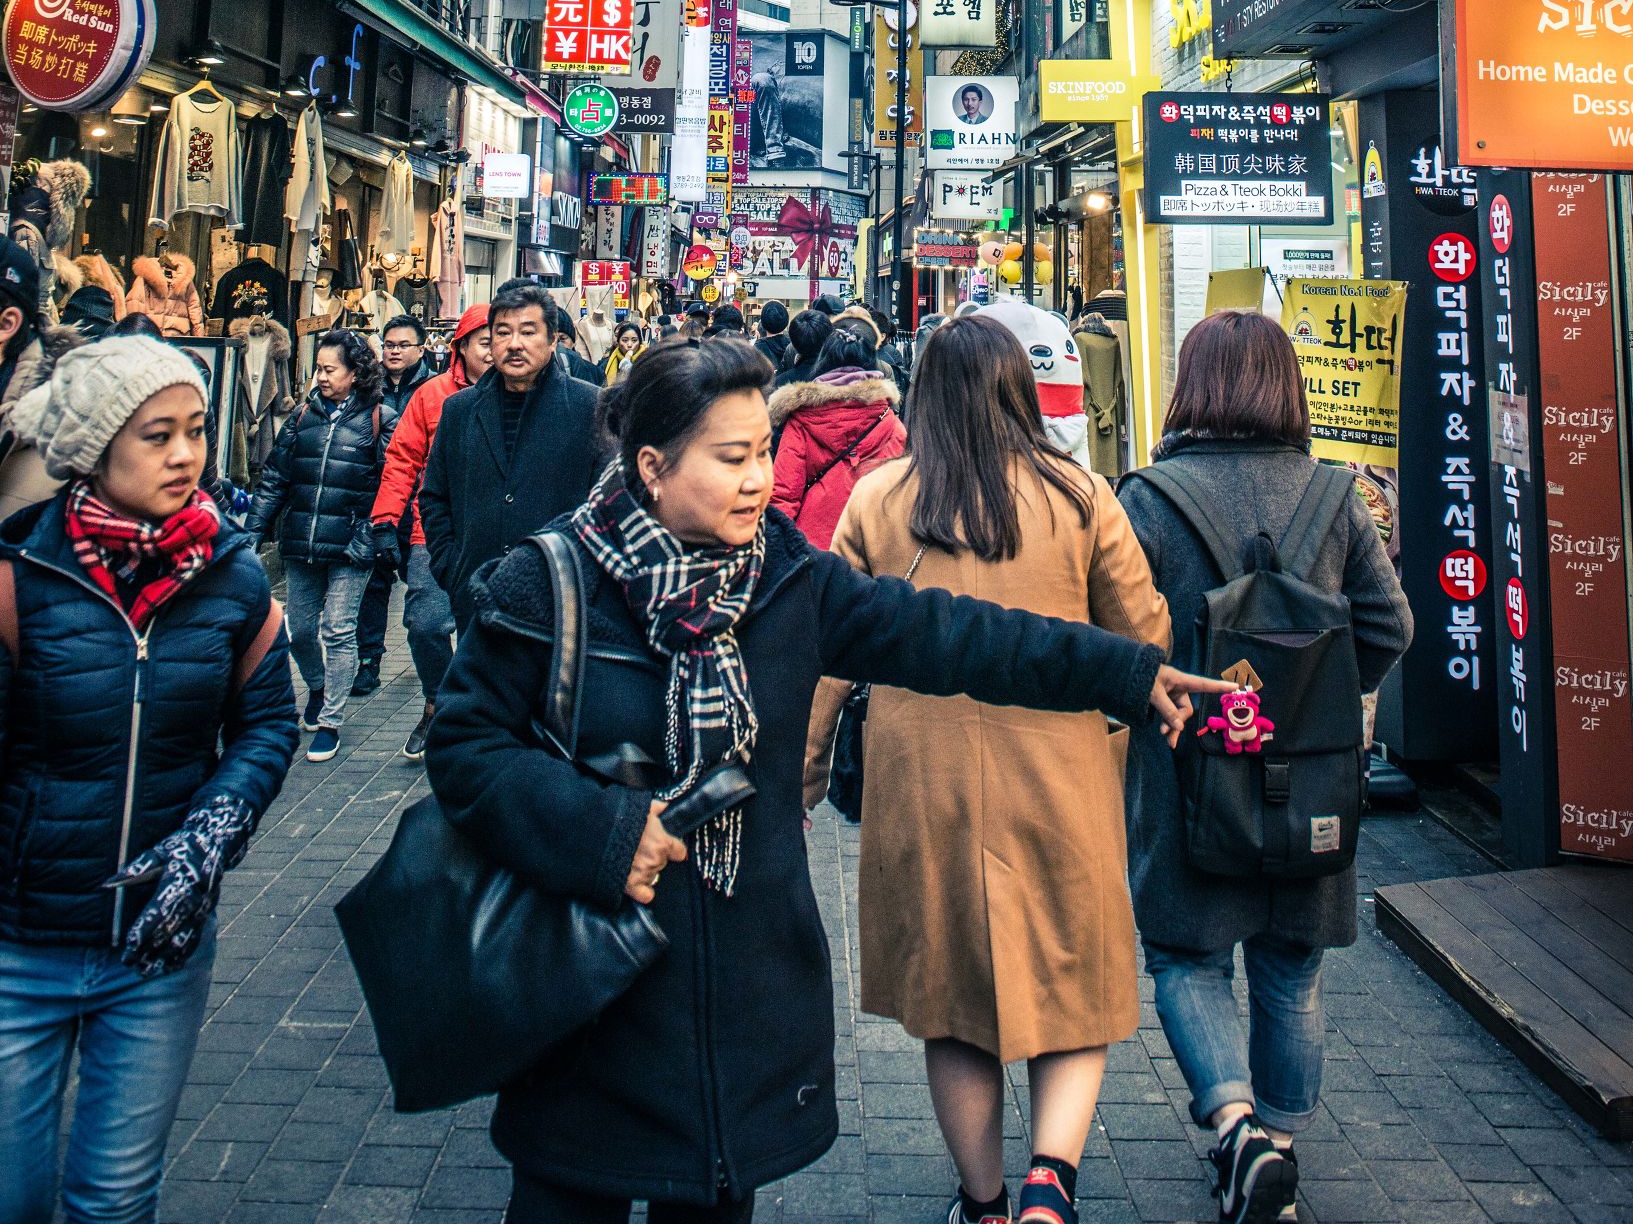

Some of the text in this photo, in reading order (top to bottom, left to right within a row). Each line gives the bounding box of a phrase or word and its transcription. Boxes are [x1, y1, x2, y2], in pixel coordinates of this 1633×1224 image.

[62, 7, 114, 34] Red Sun
[19, 20, 98, 59] 即席トッポッキ
[590, 34, 631, 60] HK
[793, 40, 817, 64] 10
[13, 43, 89, 84] 当场炒打糕
[1478, 59, 1547, 82] Home
[1553, 61, 1618, 84] Made
[1048, 80, 1126, 94] SKINFOOD
[619, 95, 652, 110] 명동점
[1067, 94, 1090, 102] since
[619, 113, 666, 126] 3-0092
[1161, 103, 1321, 124] 화덕피자&즉석떡볶이
[958, 132, 1017, 145] RIAHN
[1189, 128, 1299, 143] 피자! 떡볶이를 만나다!
[1173, 152, 1309, 176] 韩国顶尖味家
[1184, 183, 1304, 198] Pizza & Tteok Bokki
[1415, 186, 1459, 197] HWA TTEOK
[1547, 183, 1586, 199] 시실리
[1557, 203, 1577, 217] 2F
[916, 245, 979, 258] DESSERT
[1302, 284, 1391, 298] Korean No.1 Food
[1538, 280, 1609, 307] Sicily
[1553, 306, 1592, 323] 시실리
[1323, 301, 1398, 376] 화떡
[1562, 327, 1583, 342] 2F
[1297, 354, 1374, 373] 덕피자&즉석떡볶이
[1331, 379, 1361, 398] SET
[1543, 405, 1616, 434] Sicily
[1311, 426, 1338, 437] 트메뉴가
[1558, 433, 1597, 449] 시실리
[1434, 239, 1483, 690] 화덕피자&즉석떡볶이
[1568, 451, 1588, 466] 2F
[1491, 203, 1528, 752] 화덕피자&즉석떡볶이
[1549, 532, 1622, 562] Sicily
[1565, 560, 1604, 578] 시실리
[1575, 582, 1595, 597] 2F
[1555, 666, 1627, 698] Sicily
[1571, 695, 1610, 713] 시실리
[1581, 716, 1601, 731] 2F
[1561, 803, 1633, 838] Sicily
[1577, 835, 1616, 852] 시실리
